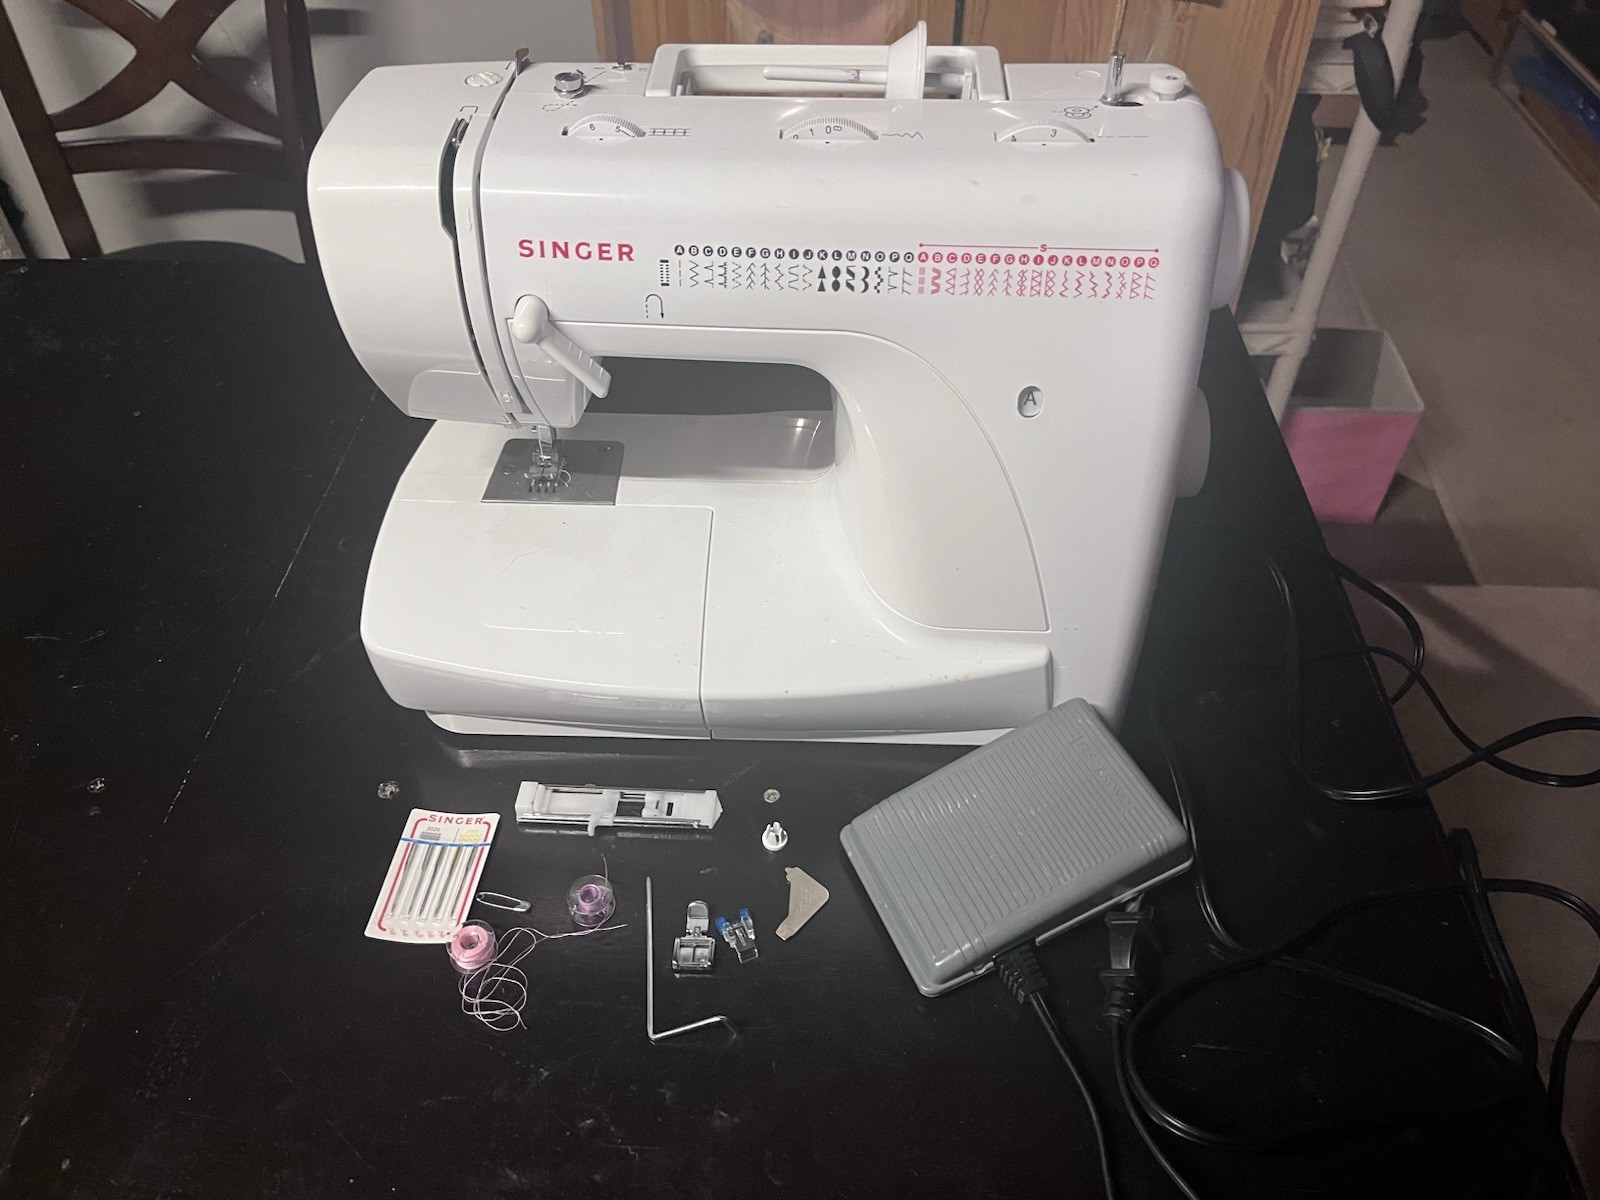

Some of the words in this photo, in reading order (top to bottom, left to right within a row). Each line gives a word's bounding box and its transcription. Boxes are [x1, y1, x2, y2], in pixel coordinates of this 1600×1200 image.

[810, 128, 814, 136] 1
[826, 126, 832, 134] 0
[1050, 129, 1057, 137] 3
[518, 239, 634, 261] SINGER
[1024, 391, 1036, 406] A
[428, 814, 483, 824] SINGER
